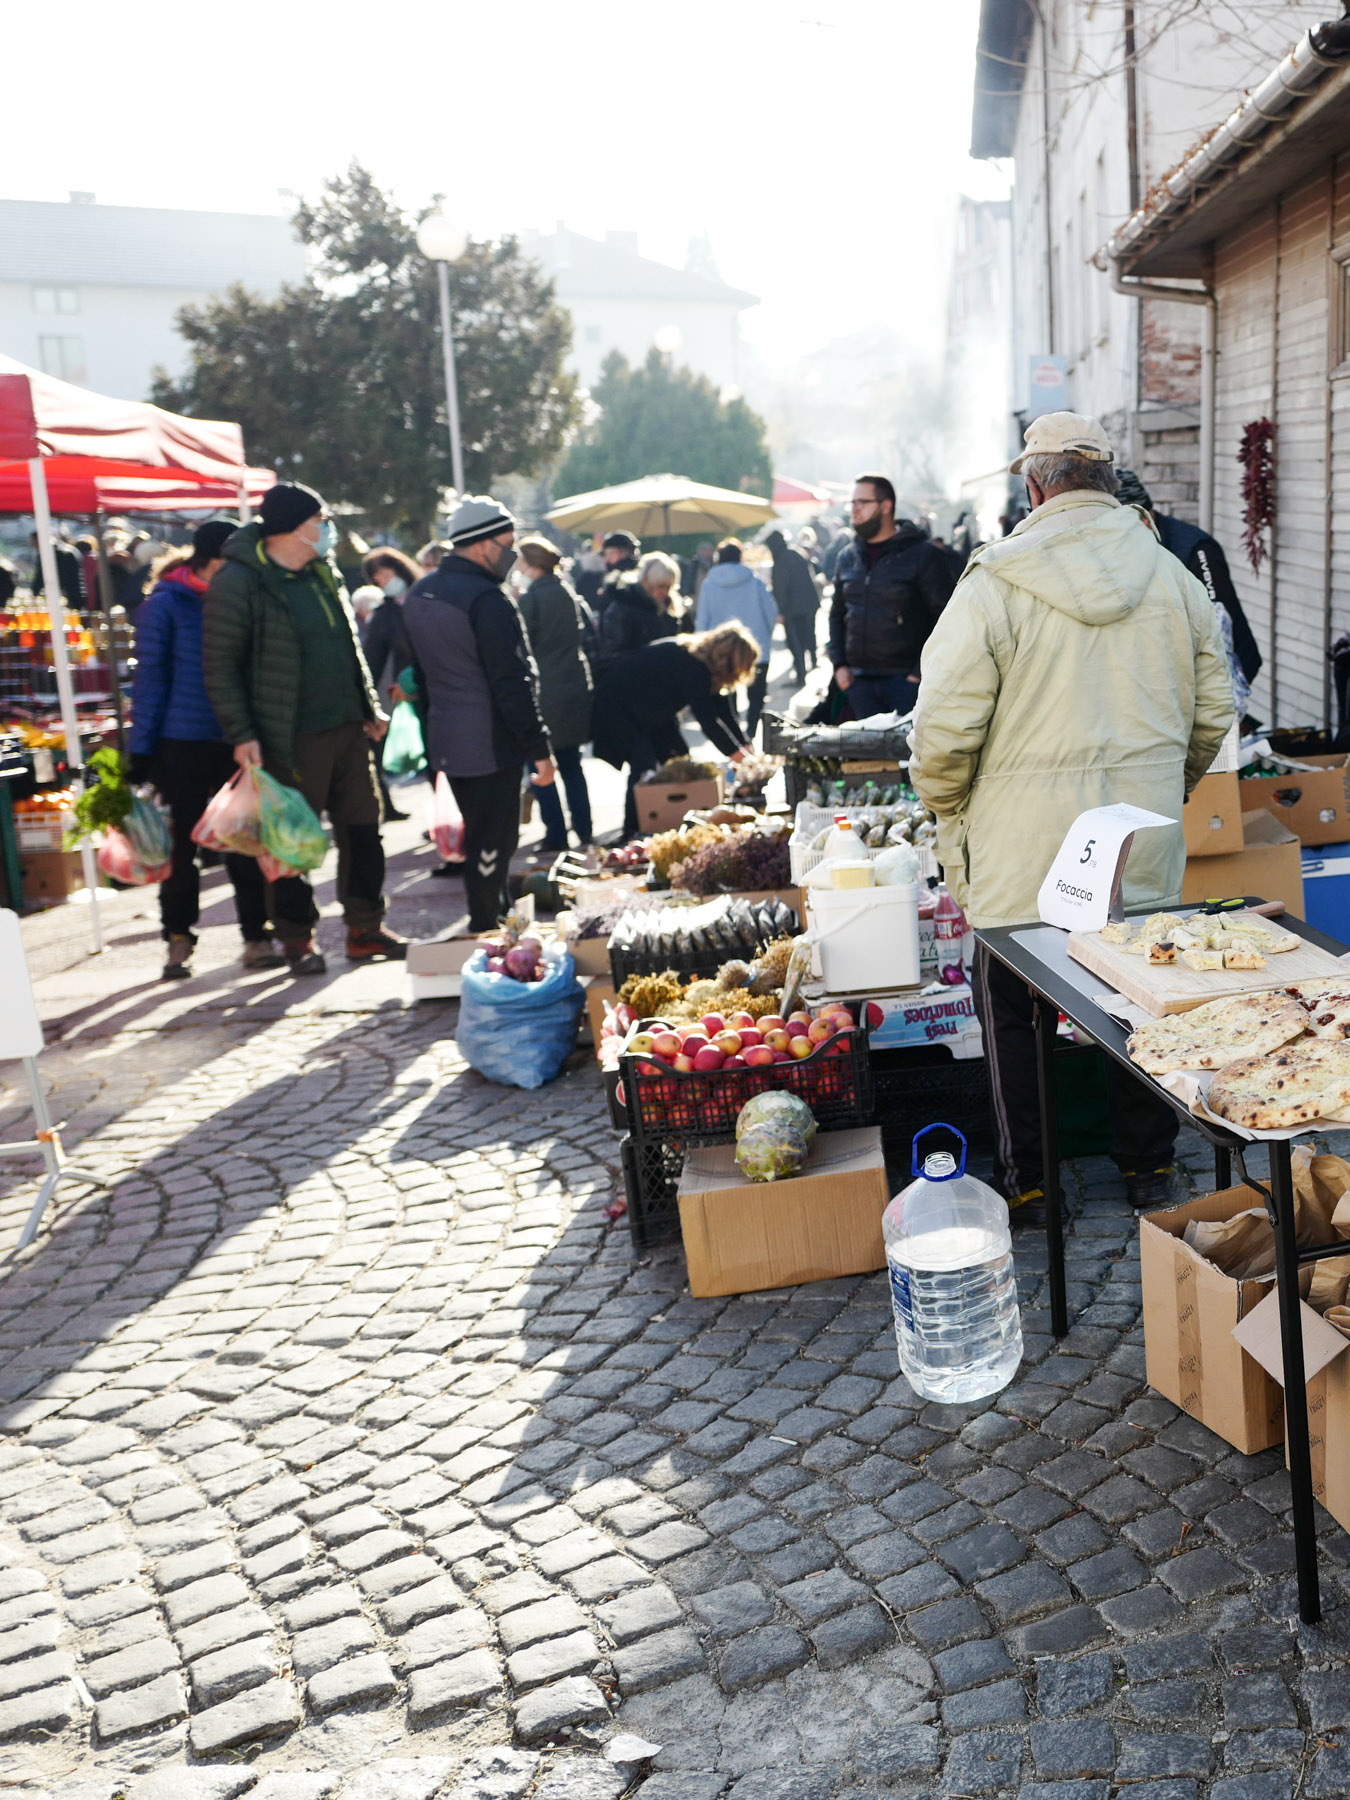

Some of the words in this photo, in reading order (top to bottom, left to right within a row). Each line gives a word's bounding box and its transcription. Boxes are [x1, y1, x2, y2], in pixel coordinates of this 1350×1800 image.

[1080, 840, 1096, 864] 5
[1056, 879, 1093, 902] Focaccia
[903, 997, 977, 1026] Tomatoes
[924, 1021, 959, 1042] Fresh
